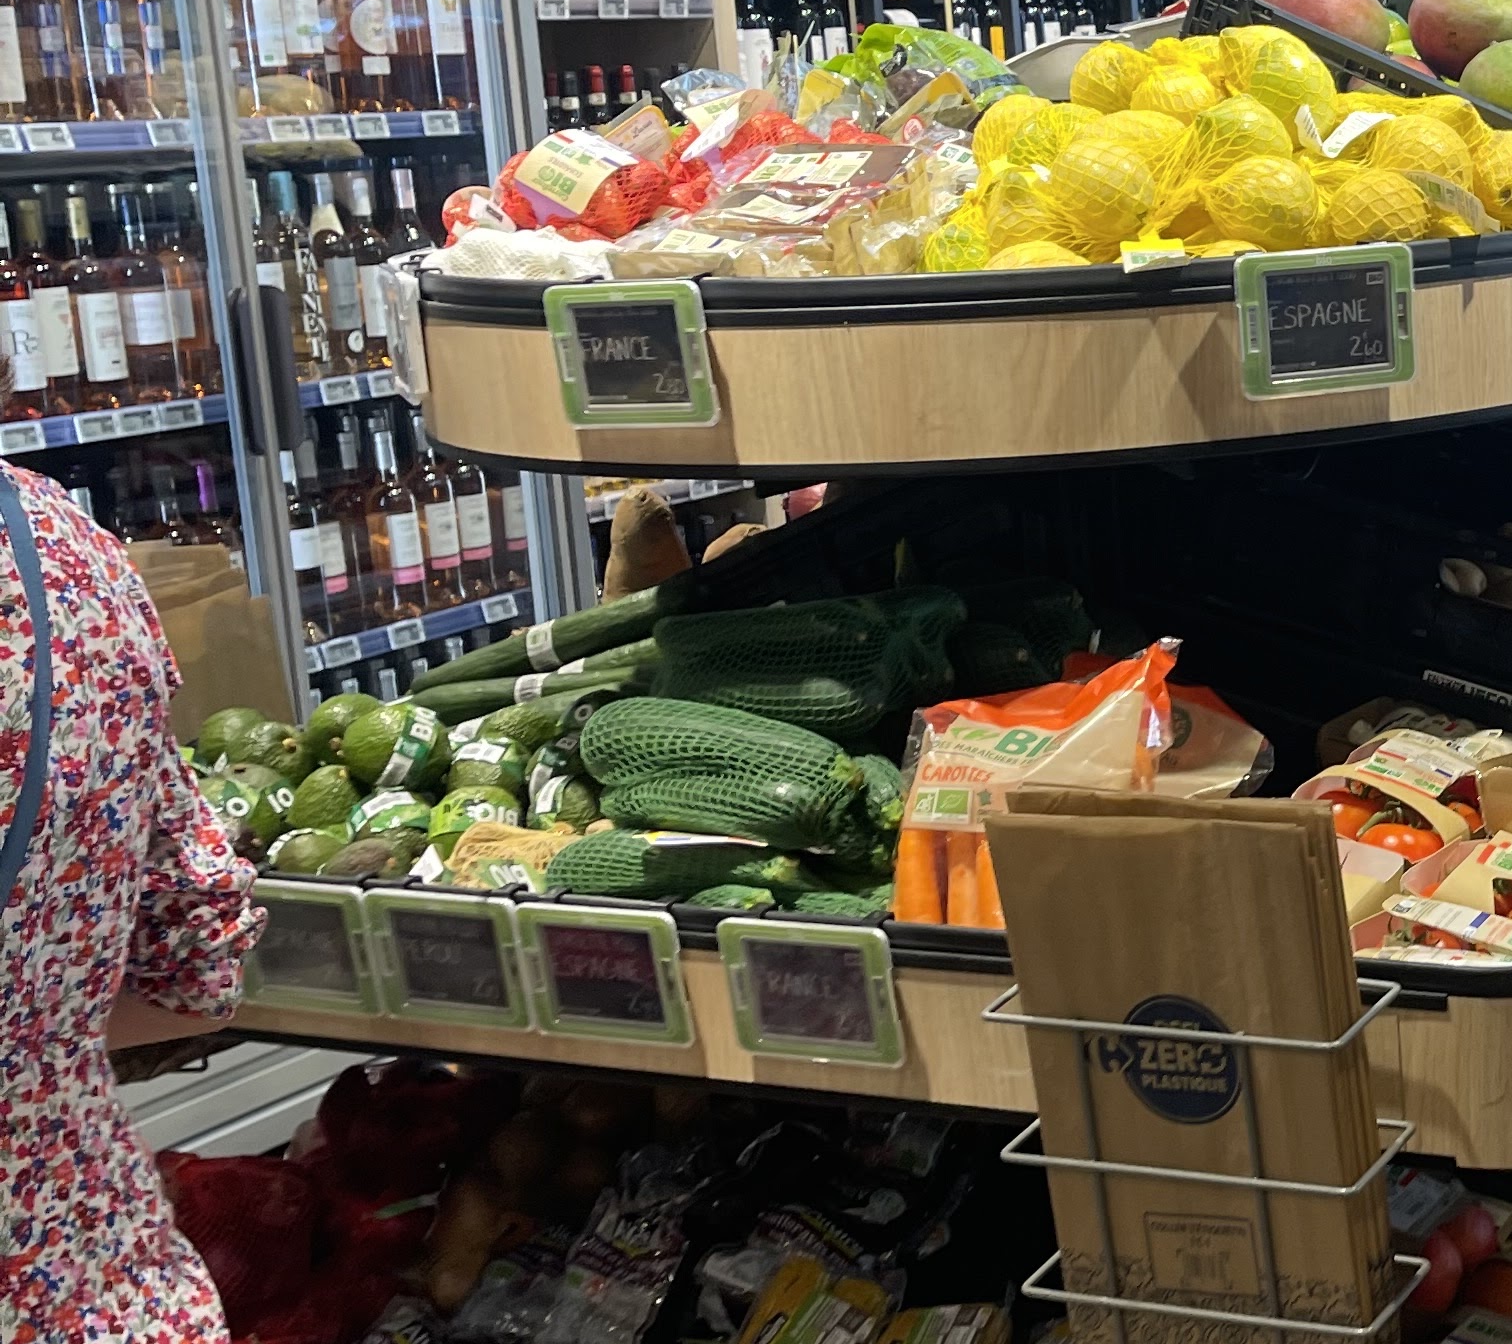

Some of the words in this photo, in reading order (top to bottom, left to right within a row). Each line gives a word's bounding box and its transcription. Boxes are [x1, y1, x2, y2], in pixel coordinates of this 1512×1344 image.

[1269, 297, 1373, 331] ESPAGNE
[921, 762, 996, 784] CAROTTES
[1140, 1073, 1229, 1094] PLASTIQUE
